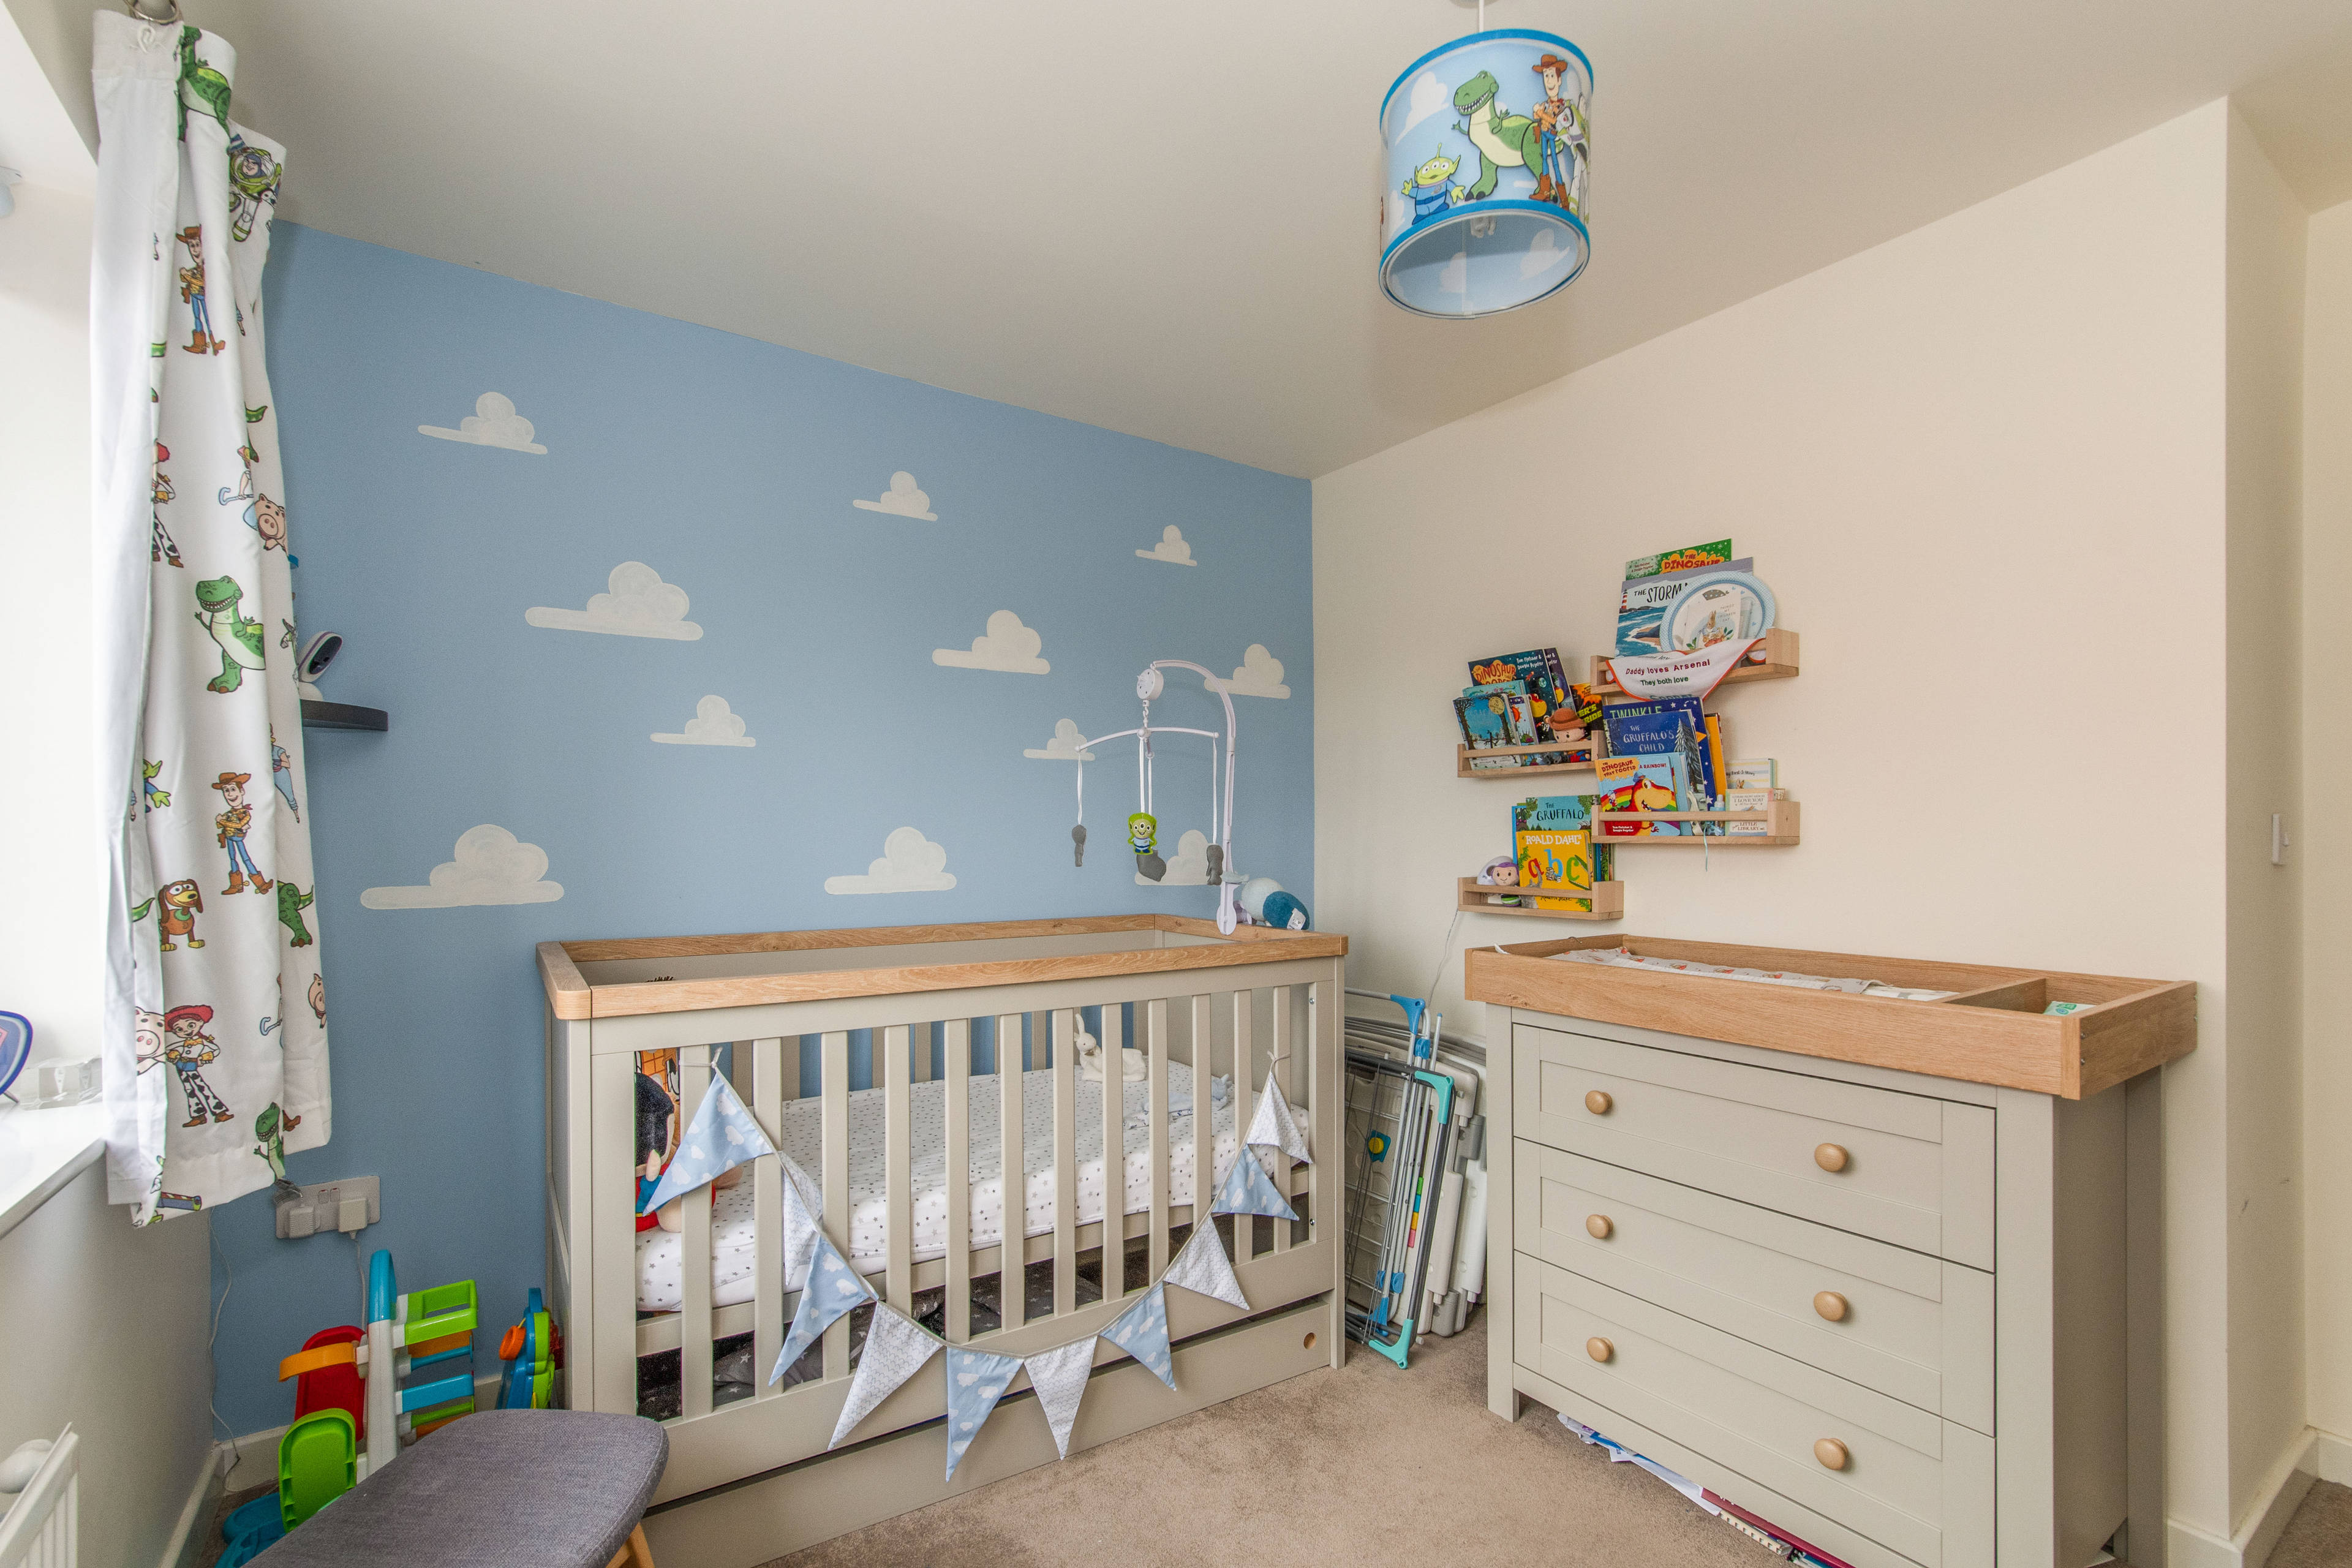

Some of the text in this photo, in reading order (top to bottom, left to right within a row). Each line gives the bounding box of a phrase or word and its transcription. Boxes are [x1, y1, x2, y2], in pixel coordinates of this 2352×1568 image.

[1664, 559, 1721, 570] DINOSAUR
[1646, 583, 1683, 603] STORM
[1673, 658, 1711, 671] Arsenal
[1476, 663, 1516, 683] DINOSAUR
[1578, 704, 1597, 717] ER'S
[1583, 710, 1602, 724] RIDE
[1610, 706, 1662, 719] TWINKLE
[1623, 729, 1675, 743] GRUFFALO'S
[1639, 743, 1665, 753] CHILD
[1602, 760, 1634, 772] DINOSAUR
[1615, 765, 1636, 774] POOPED
[1536, 809, 1585, 821] GRUFFALO
[1526, 835, 1553, 845] ROALD
